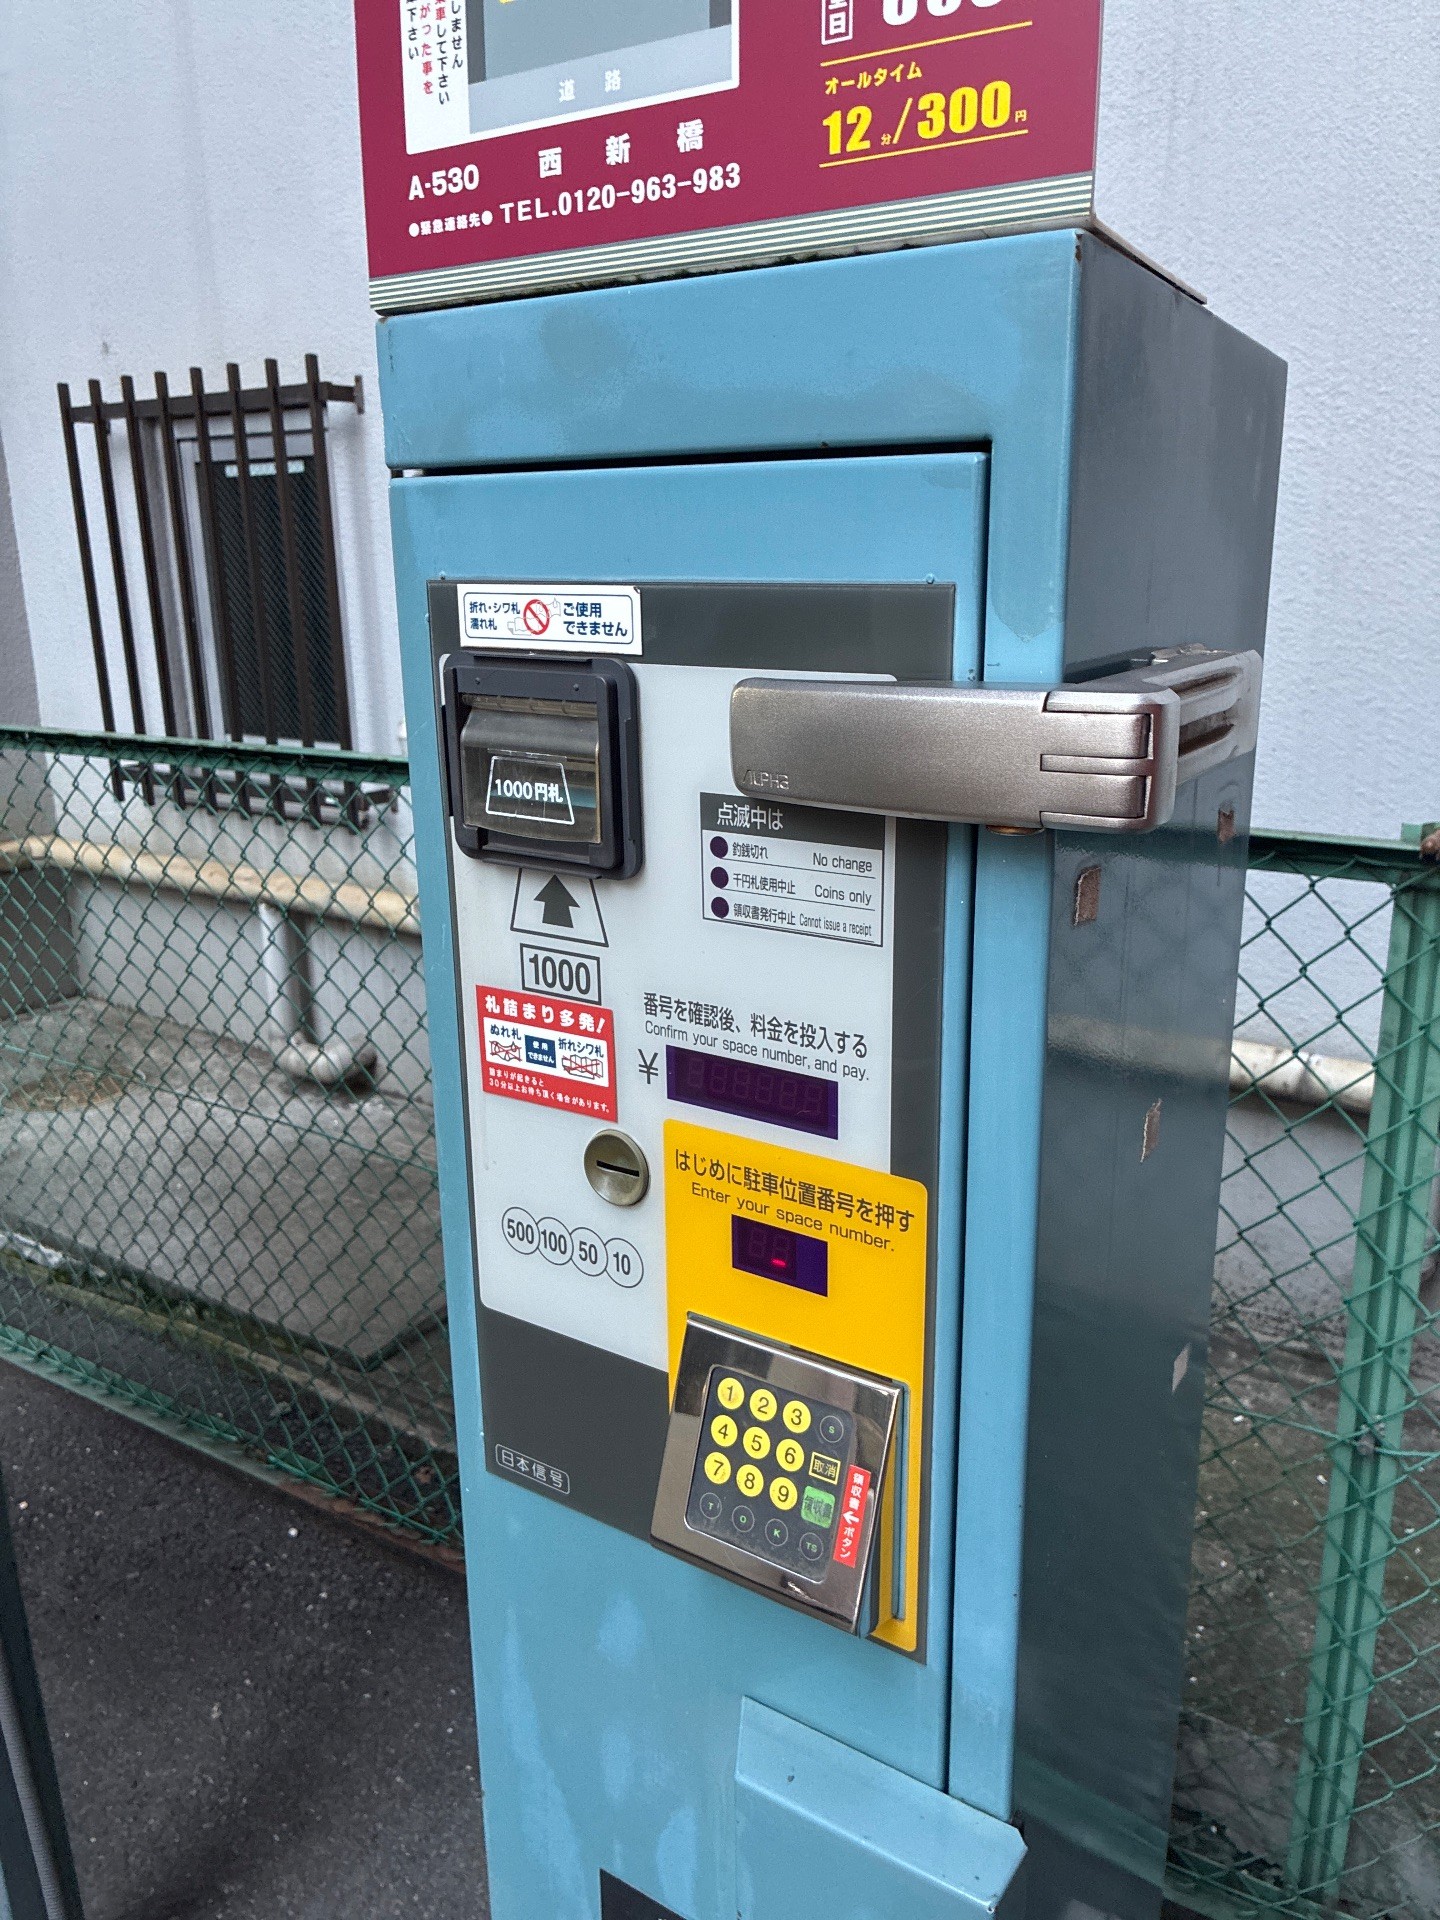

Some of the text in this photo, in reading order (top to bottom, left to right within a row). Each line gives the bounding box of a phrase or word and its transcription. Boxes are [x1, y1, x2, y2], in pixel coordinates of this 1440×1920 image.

[406, 0, 419, 60] 下さい
[451, 0, 463, 69] しません
[434, 0, 449, 105] 車して下さい
[557, 70, 621, 103] 道路
[825, 62, 922, 95] オールタイム
[538, 118, 704, 179] 西新橋
[408, 164, 480, 201] A-530
[499, 162, 741, 224] TEL.0120-963-983
[469, 601, 602, 618] 折れ・シワ札 ご使用
[470, 618, 628, 637] 濡れ札 できません
[495, 778, 563, 803] 1000円札
[717, 802, 784, 831] 点滅中は
[732, 842, 873, 873] 釣銭切れ No change
[733, 873, 872, 905] 千円札使用中止 Coins only
[733, 903, 872, 937] 領収書発行中止 Cannot issue a receipt
[528, 953, 591, 995] 1000
[490, 1023, 521, 1040] ぬれ札
[643, 992, 868, 1059] 番号を確認後、料金を投入する
[528, 1051, 554, 1064] できません
[532, 1040, 549, 1051] 使用
[558, 1037, 604, 1058] 折れシワ札
[645, 1020, 869, 1082] Confirm your space number, and pay.
[638, 1049, 659, 1085] ¥
[675, 1148, 915, 1233] はじめに駐車位置番号を押す
[507, 1218, 534, 1244] 500
[691, 1182, 895, 1252] Enter your space number.
[541, 1229, 567, 1255] 100
[578, 1240, 598, 1265] 50
[613, 1251, 631, 1275] 10
[726, 1386, 835, 1434] 1 2 3 S
[718, 1424, 797, 1464] 4 5 6
[501, 1449, 563, 1488] 日本信号
[713, 1460, 790, 1503] 7 8 9
[813, 1458, 837, 1478] 取消
[773, 1529, 781, 1538] K
[806, 1541, 818, 1553] TS
